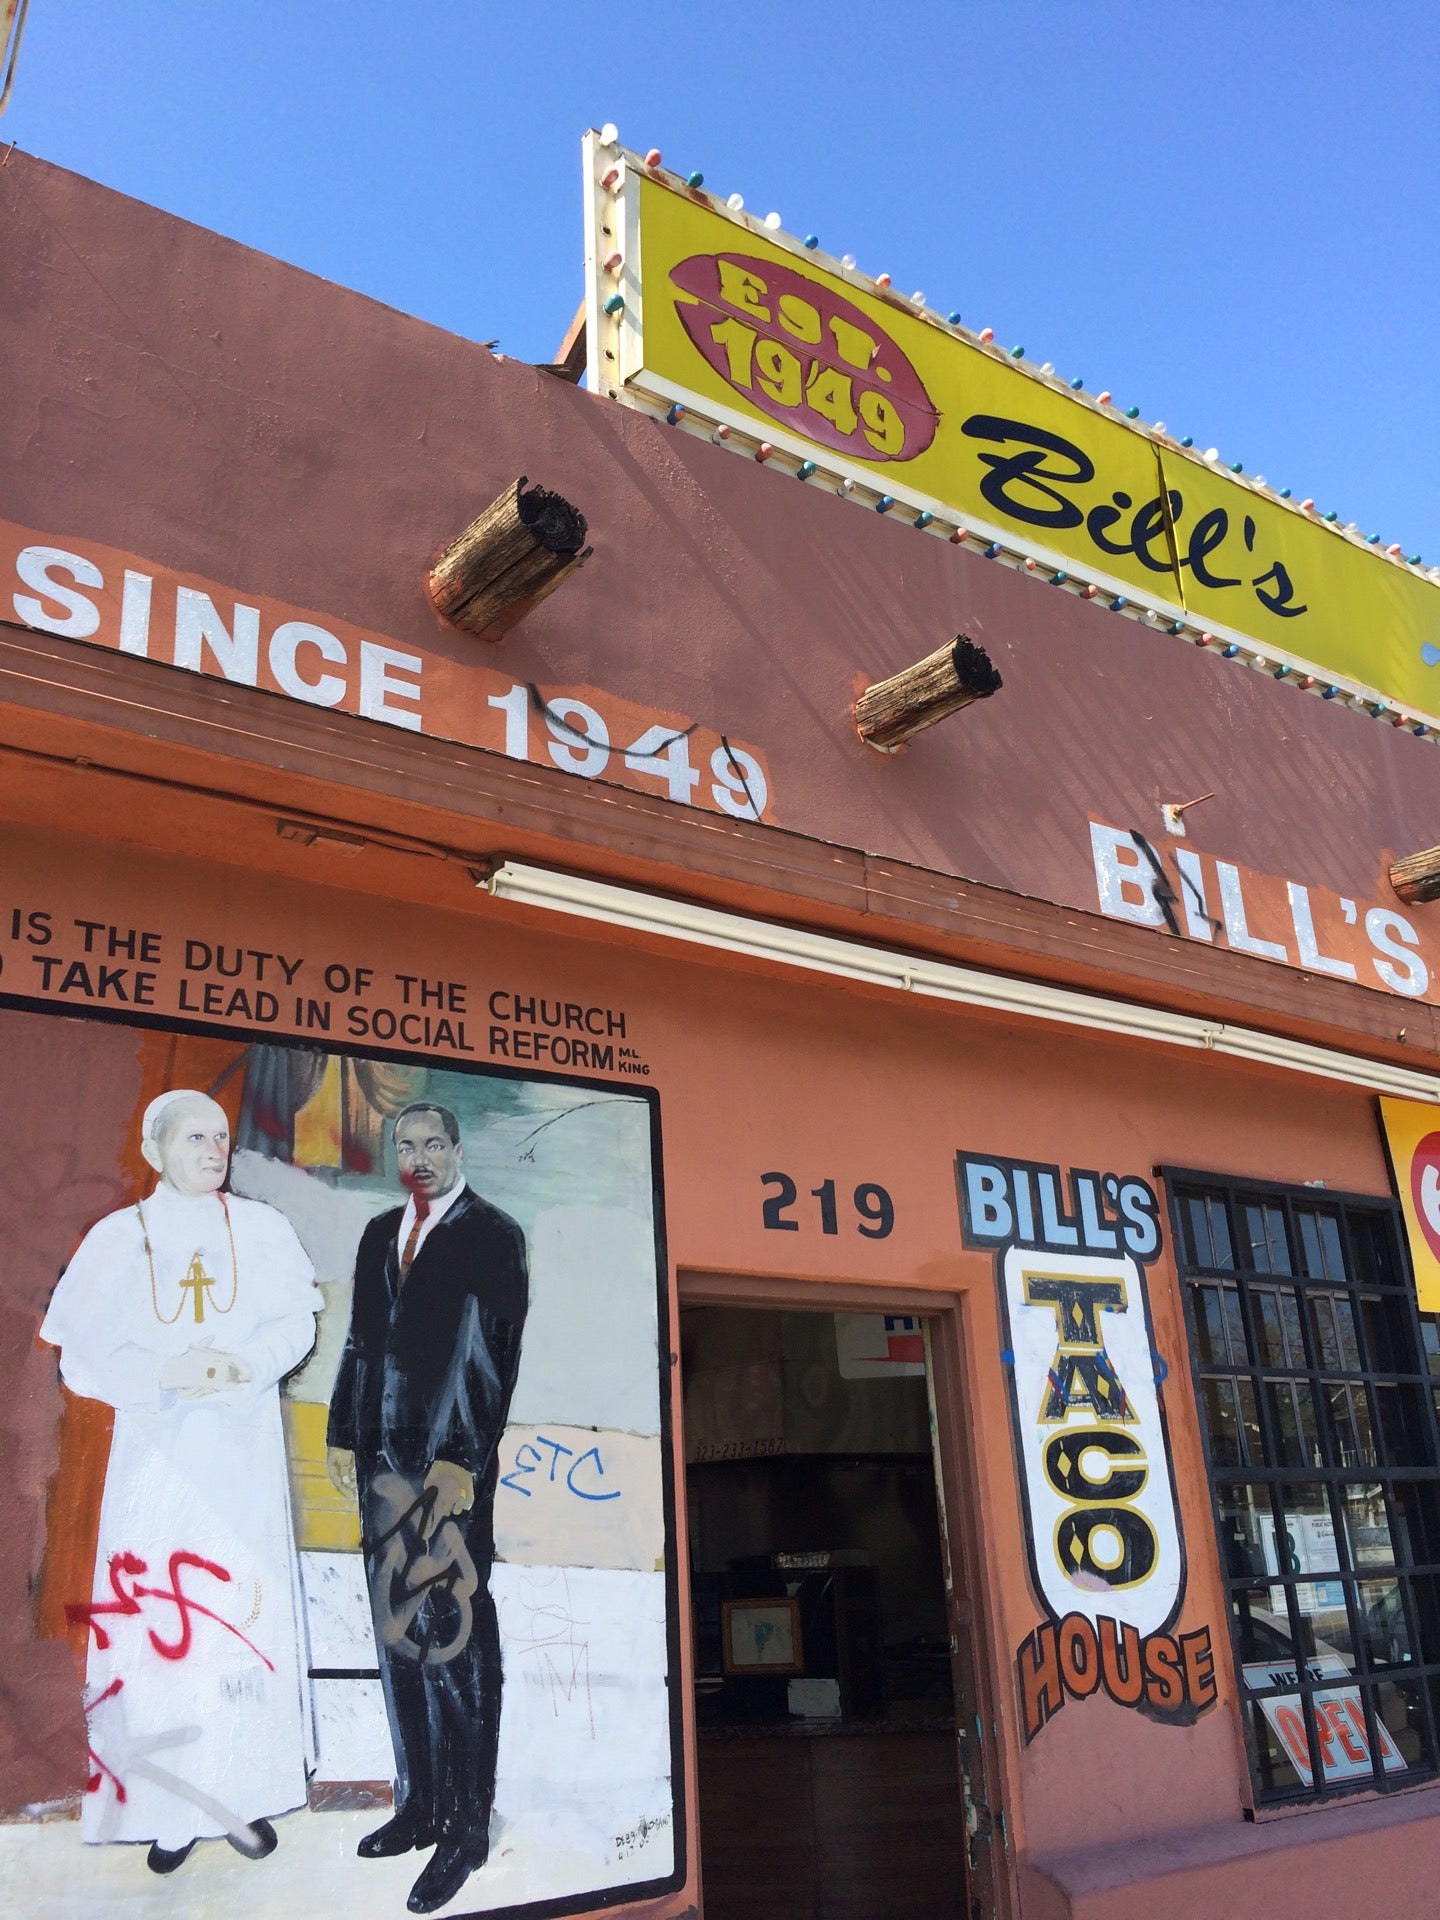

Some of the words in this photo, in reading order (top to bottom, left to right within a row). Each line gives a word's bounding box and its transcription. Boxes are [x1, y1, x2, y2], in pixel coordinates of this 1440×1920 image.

[716, 258, 893, 384] EST.
[960, 414, 1308, 618] Bill's
[12, 545, 423, 732] SINCE
[486, 682, 769, 822] 1949
[1088, 820, 1430, 998] BILL'S
[10, 908, 53, 946] IS
[73, 919, 163, 964] THE
[184, 939, 305, 986] DUTY
[324, 963, 374, 997] OF
[394, 973, 468, 1014] THE
[488, 990, 627, 1039] CHURCH
[31, 954, 158, 1006] TAKE
[178, 978, 280, 1023] LEAD
[294, 997, 331, 1031] IN
[346, 1005, 475, 1052] SOCIAL
[488, 1025, 614, 1071] REFORM
[618, 1060, 651, 1076] KING
[759, 1171, 895, 1240] 219
[961, 1159, 1161, 1263] BILL'S
[1020, 1269, 1161, 1593] TACO
[1017, 1610, 1220, 1746] HOUSE
[1275, 1696, 1392, 1771] OPEN
